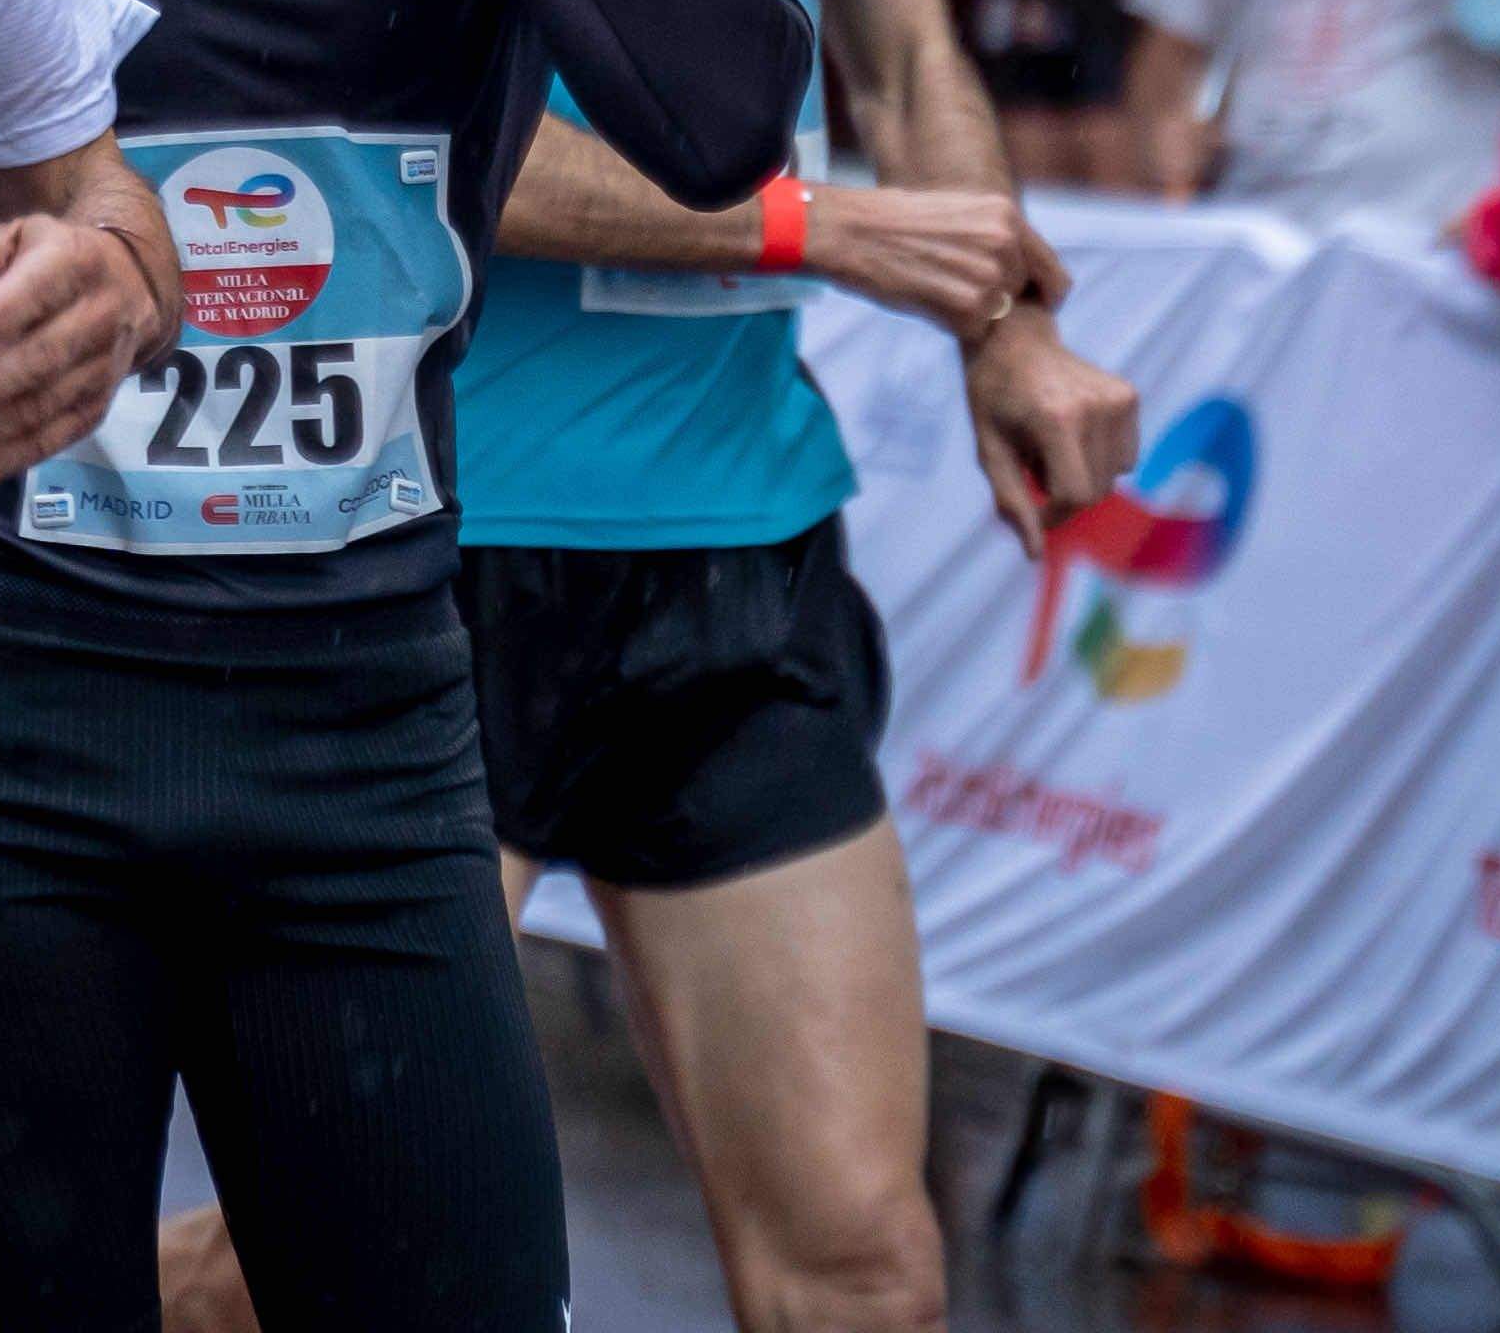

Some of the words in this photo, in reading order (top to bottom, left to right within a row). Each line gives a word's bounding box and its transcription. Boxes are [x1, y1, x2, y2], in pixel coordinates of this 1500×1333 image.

[187, 238, 298, 256] TotalEnergies
[216, 274, 269, 288] MILLA
[184, 288, 310, 307] NTERNACIONaL
[198, 308, 221, 322] DE
[224, 306, 290, 321] MADRID
[136, 342, 364, 471] 225
[80, 491, 174, 520] MADRID
[243, 493, 302, 507] MILLA
